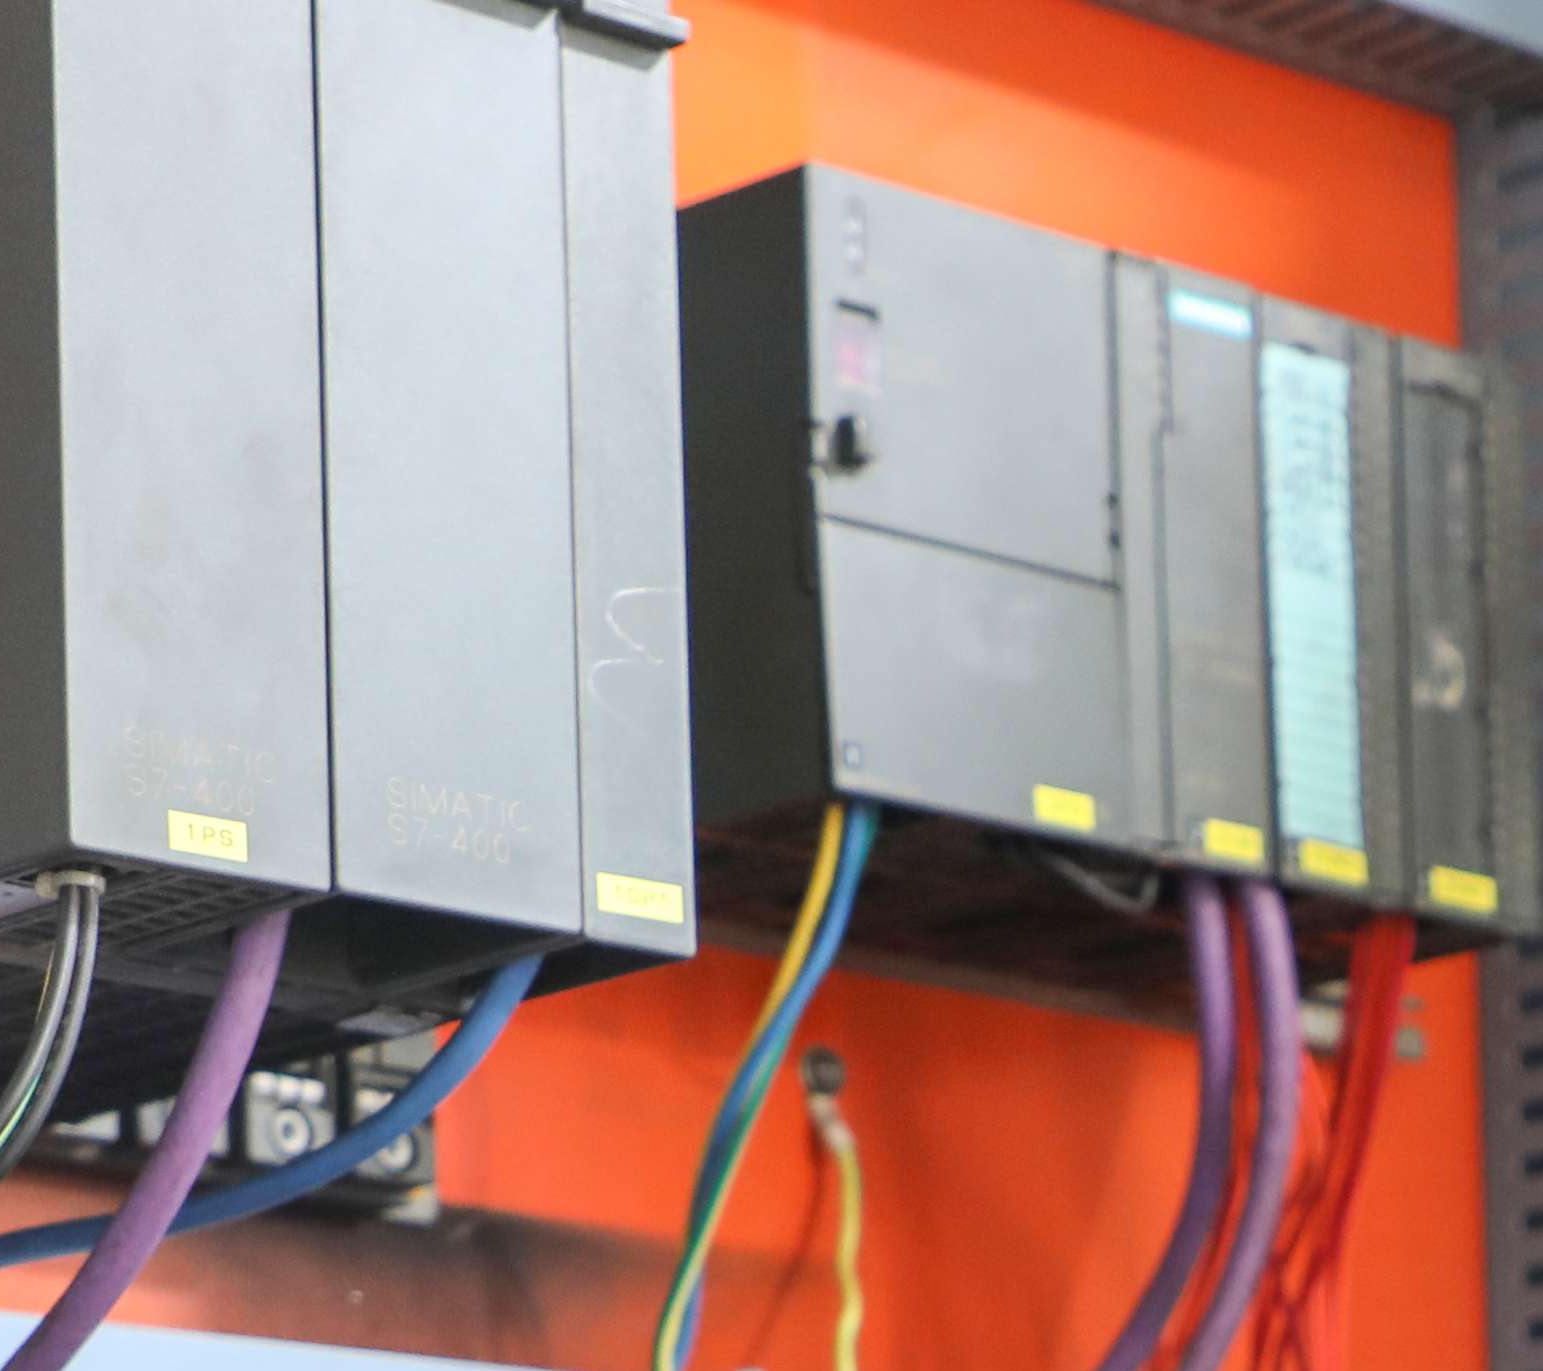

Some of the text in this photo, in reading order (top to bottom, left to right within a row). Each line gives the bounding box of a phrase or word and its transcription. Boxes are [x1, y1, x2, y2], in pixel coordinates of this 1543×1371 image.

[125, 763, 256, 817] S7-400
[386, 775, 529, 832] SIMATIC
[387, 813, 512, 865] S7-400
